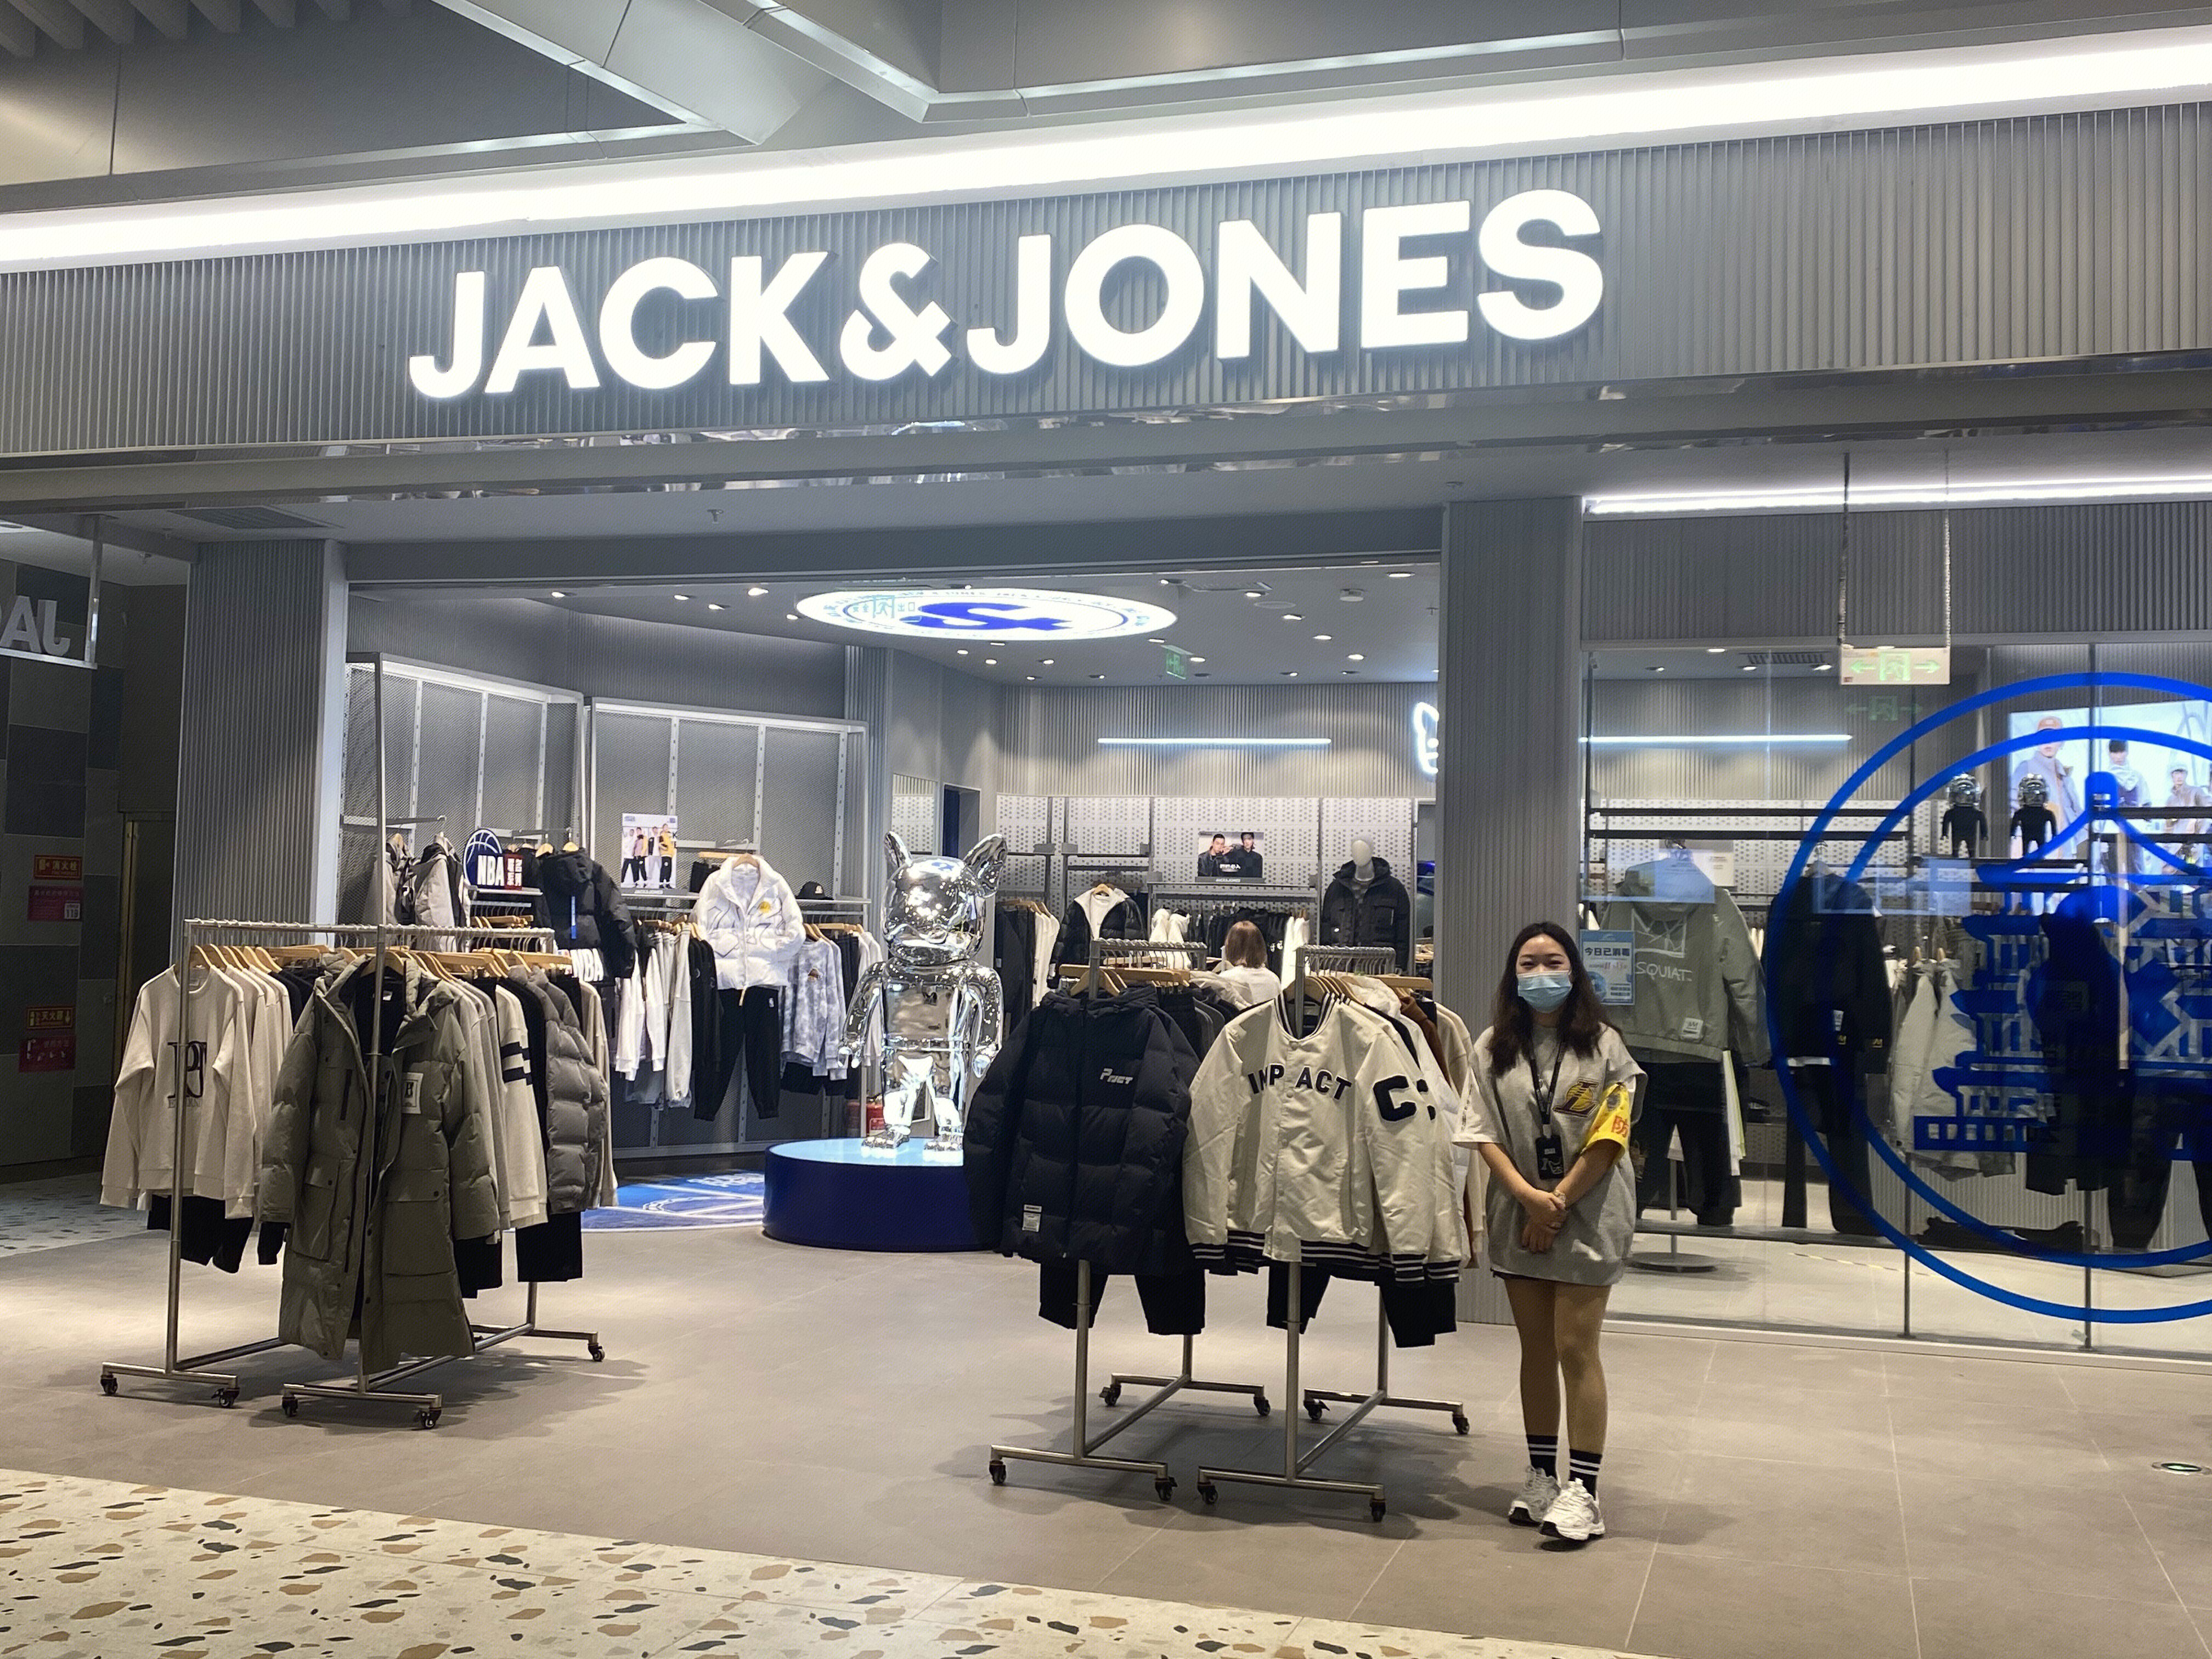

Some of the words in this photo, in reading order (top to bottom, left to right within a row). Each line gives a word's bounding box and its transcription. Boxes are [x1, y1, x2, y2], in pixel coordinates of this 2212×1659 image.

[477, 855, 505, 886] NBA
[66, 909, 80, 919] 119
[570, 948, 604, 982] NBA
